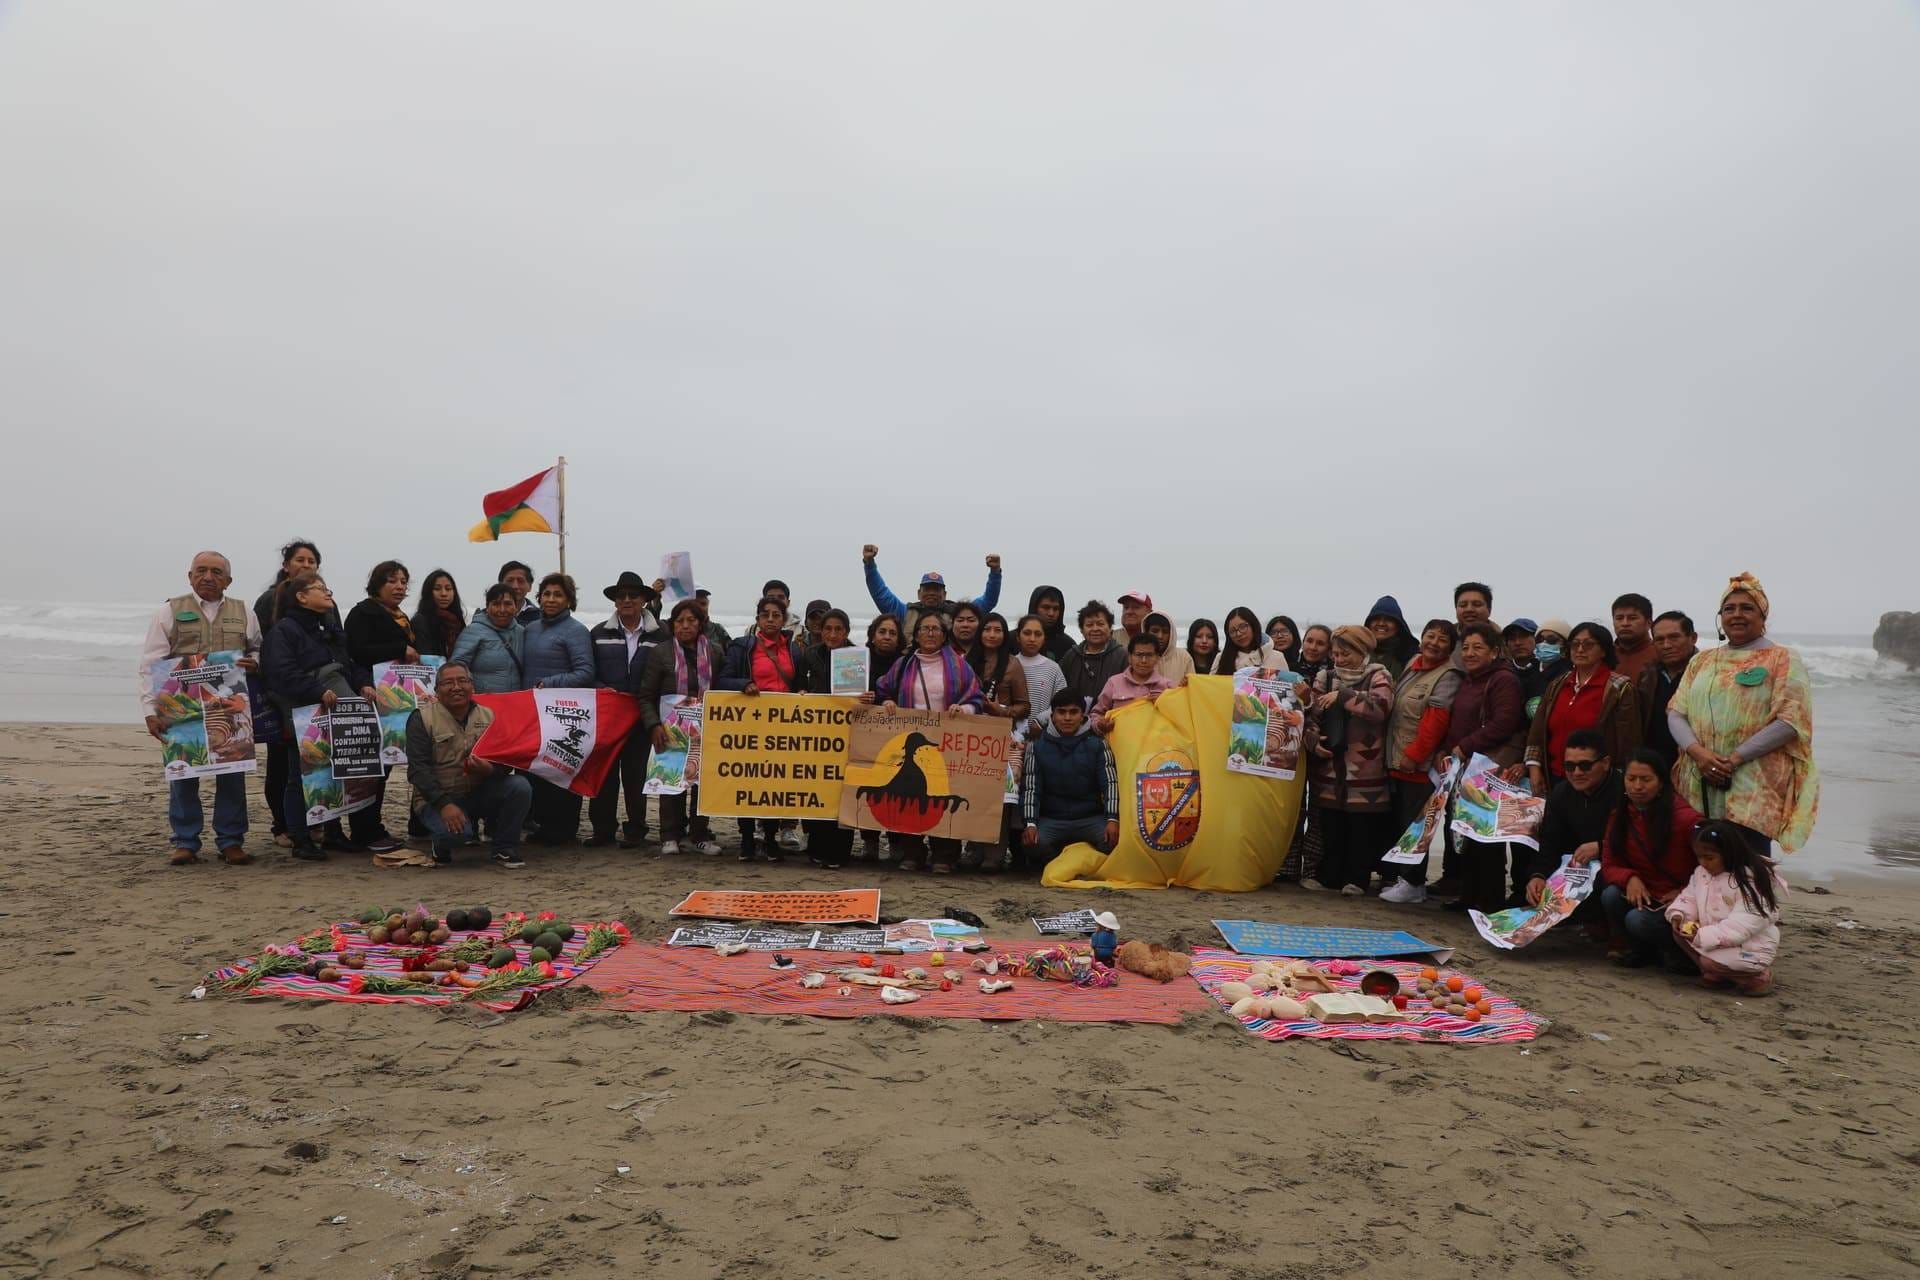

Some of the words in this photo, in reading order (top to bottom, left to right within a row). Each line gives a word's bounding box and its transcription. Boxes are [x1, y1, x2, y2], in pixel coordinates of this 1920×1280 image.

[336, 703, 352, 712] SOS
[545, 705, 591, 720] REPSOL
[709, 706, 746, 722] HAY
[752, 709, 762, 720] +
[352, 726, 371, 735] DINA
[334, 737, 371, 746] CONTAMINA
[720, 734, 758, 750] QUE
[764, 735, 845, 753] SENTIDO
[937, 732, 1008, 763] REPSOL
[718, 760, 786, 779] COMÚN
[793, 764, 817, 780] EN
[823, 765, 844, 780] EL
[736, 790, 824, 808] PLANETA.
[715, 911, 873, 920] PROSPERIDAD
